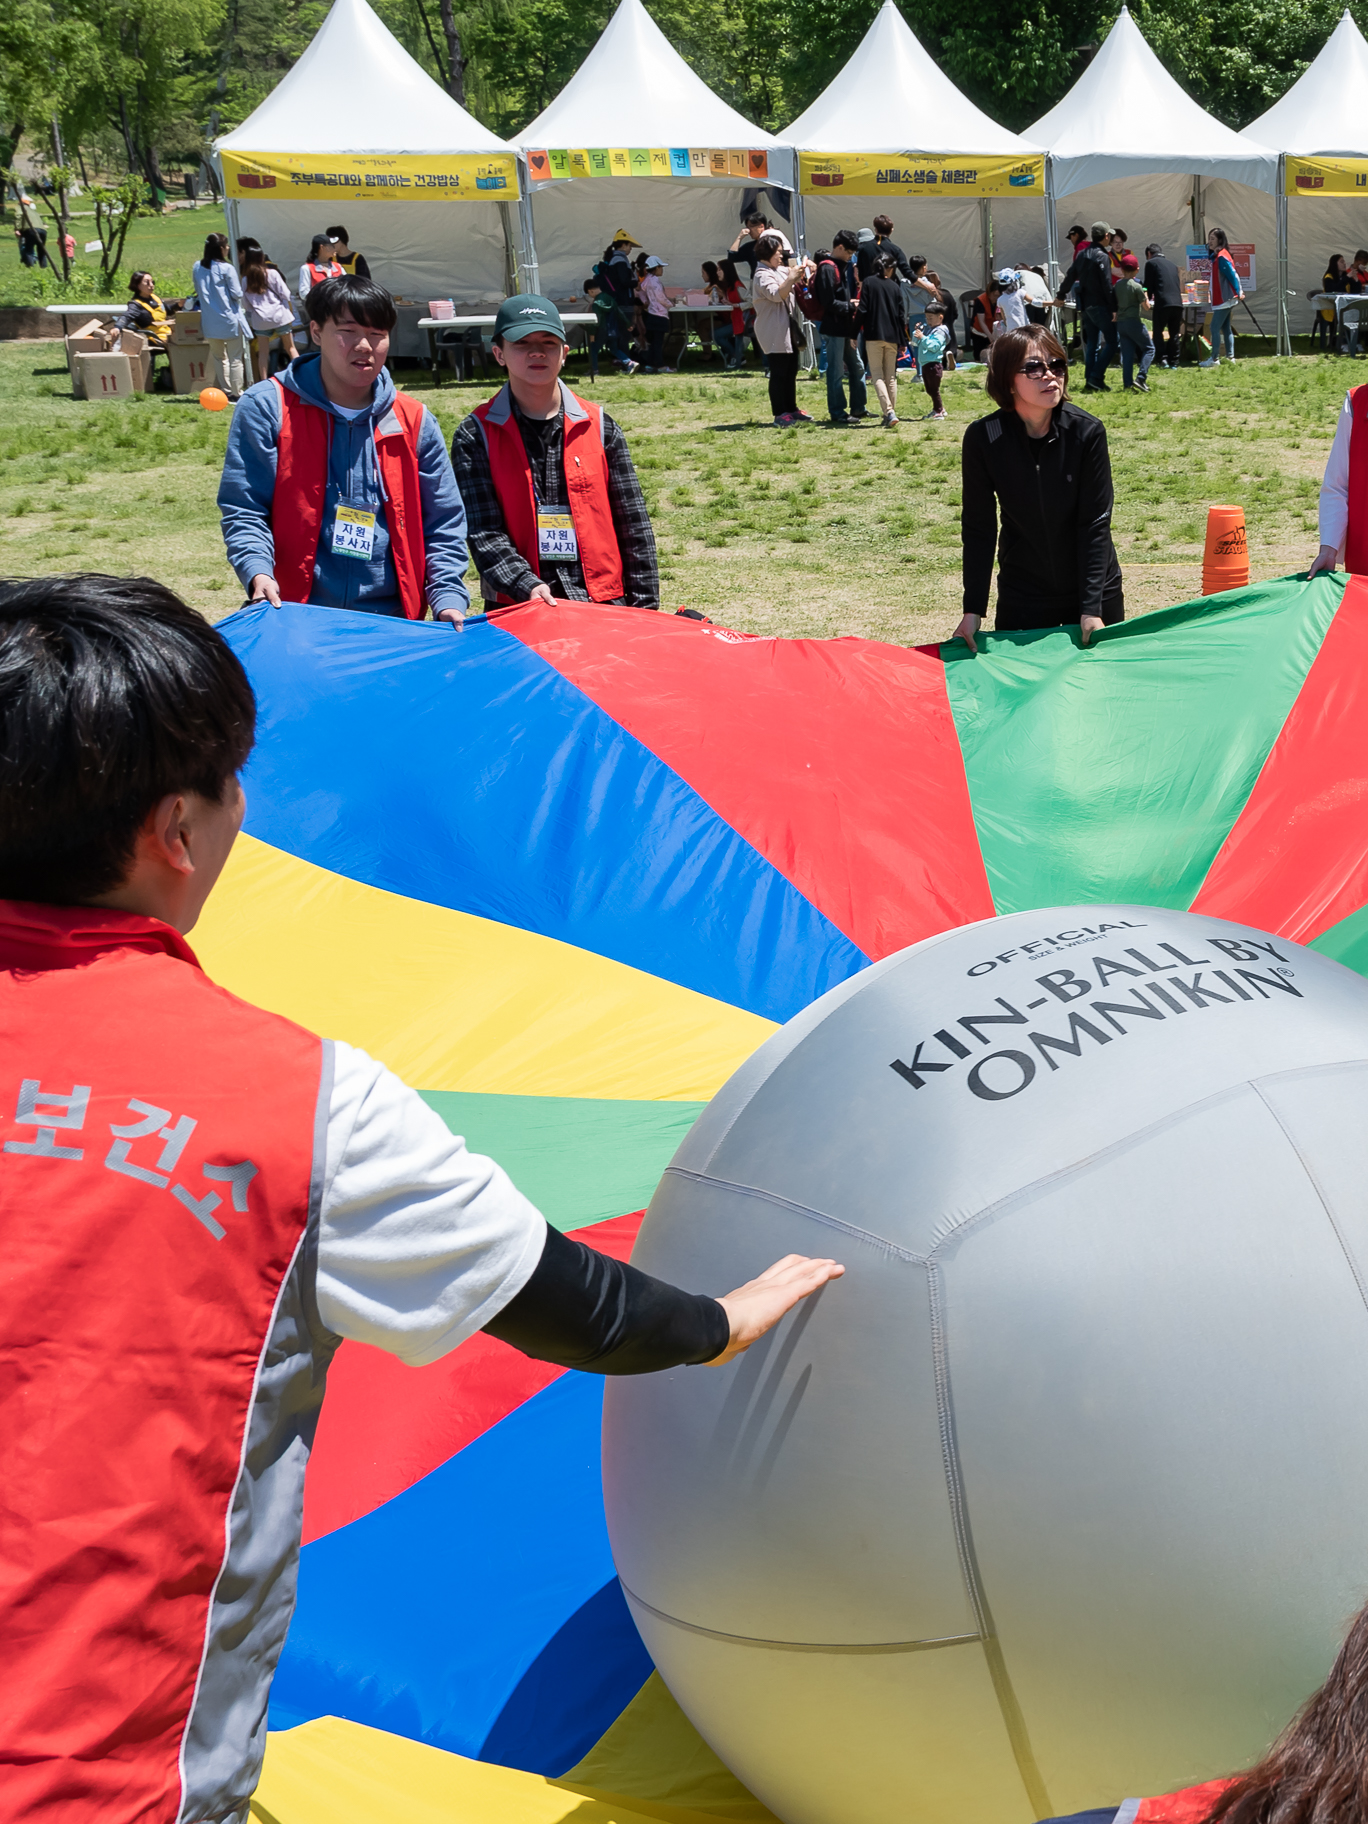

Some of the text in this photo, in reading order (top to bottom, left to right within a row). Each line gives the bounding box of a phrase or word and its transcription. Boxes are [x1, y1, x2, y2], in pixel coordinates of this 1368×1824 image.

[290, 172, 362, 187] 주부특공대와
[364, 173, 411, 188] 함께하는
[414, 174, 460, 188] 건강밥상
[876, 169, 978, 184] 심폐소생술 체험관
[1356, 173, 1366, 187] 내
[342, 523, 366, 538] 자원
[546, 530, 568, 540] 자원
[335, 534, 371, 551] 봉사자
[541, 541, 575, 553] 봉사자
[1213, 545, 1248, 555] STACK
[966, 921, 1148, 977] OFFICIAL
[1028, 949, 1053, 961] SIZE
[1064, 933, 1109, 948] WEIGHT
[889, 938, 1290, 1090] KIN-BALL BY
[3, 1078, 260, 1242] 보건소
